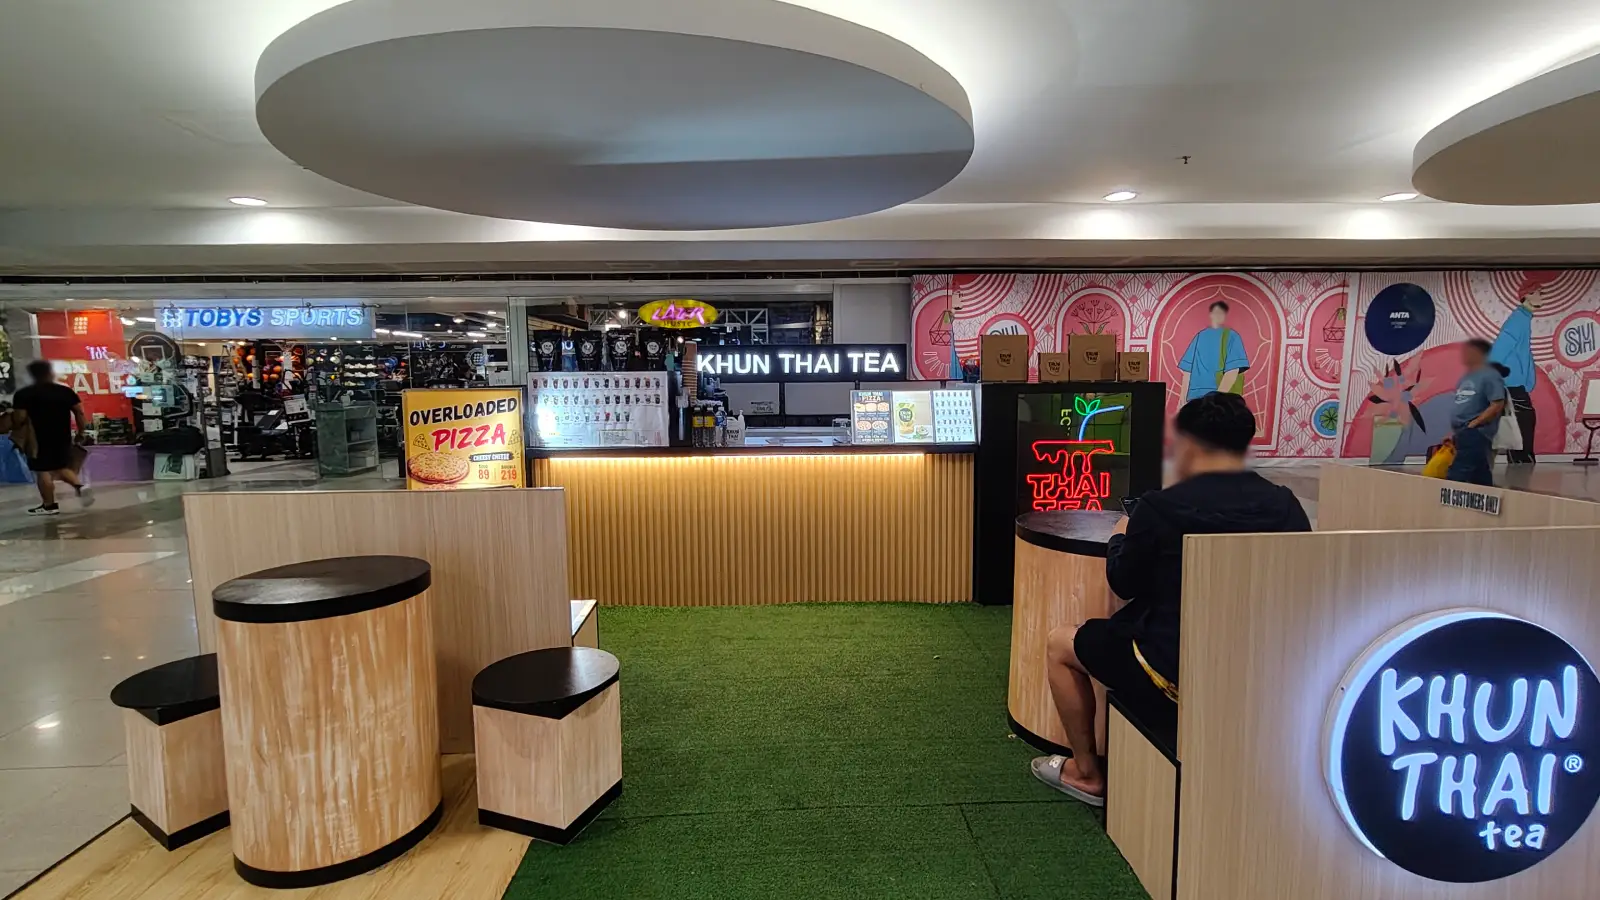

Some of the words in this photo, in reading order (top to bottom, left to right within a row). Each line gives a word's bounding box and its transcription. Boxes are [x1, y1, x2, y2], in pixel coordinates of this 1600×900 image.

[185, 308, 263, 328] TOBYS
[270, 307, 364, 327] SPORTS
[1389, 311, 1410, 319] ANTA
[697, 353, 770, 375] KHUN
[778, 353, 840, 374] THAI
[847, 352, 900, 373] TEA
[409, 397, 518, 426] OVERLOADED
[430, 422, 506, 452] PIZZA
[478, 469, 489, 480] 89
[500, 469, 517, 480] 219
[1026, 472, 1110, 499] THAI
[1452, 489, 1485, 511] CUSTOMERS
[1380, 665, 1579, 756] KHUN
[1391, 752, 1557, 821] THAI
[1478, 820, 1547, 850] tea
